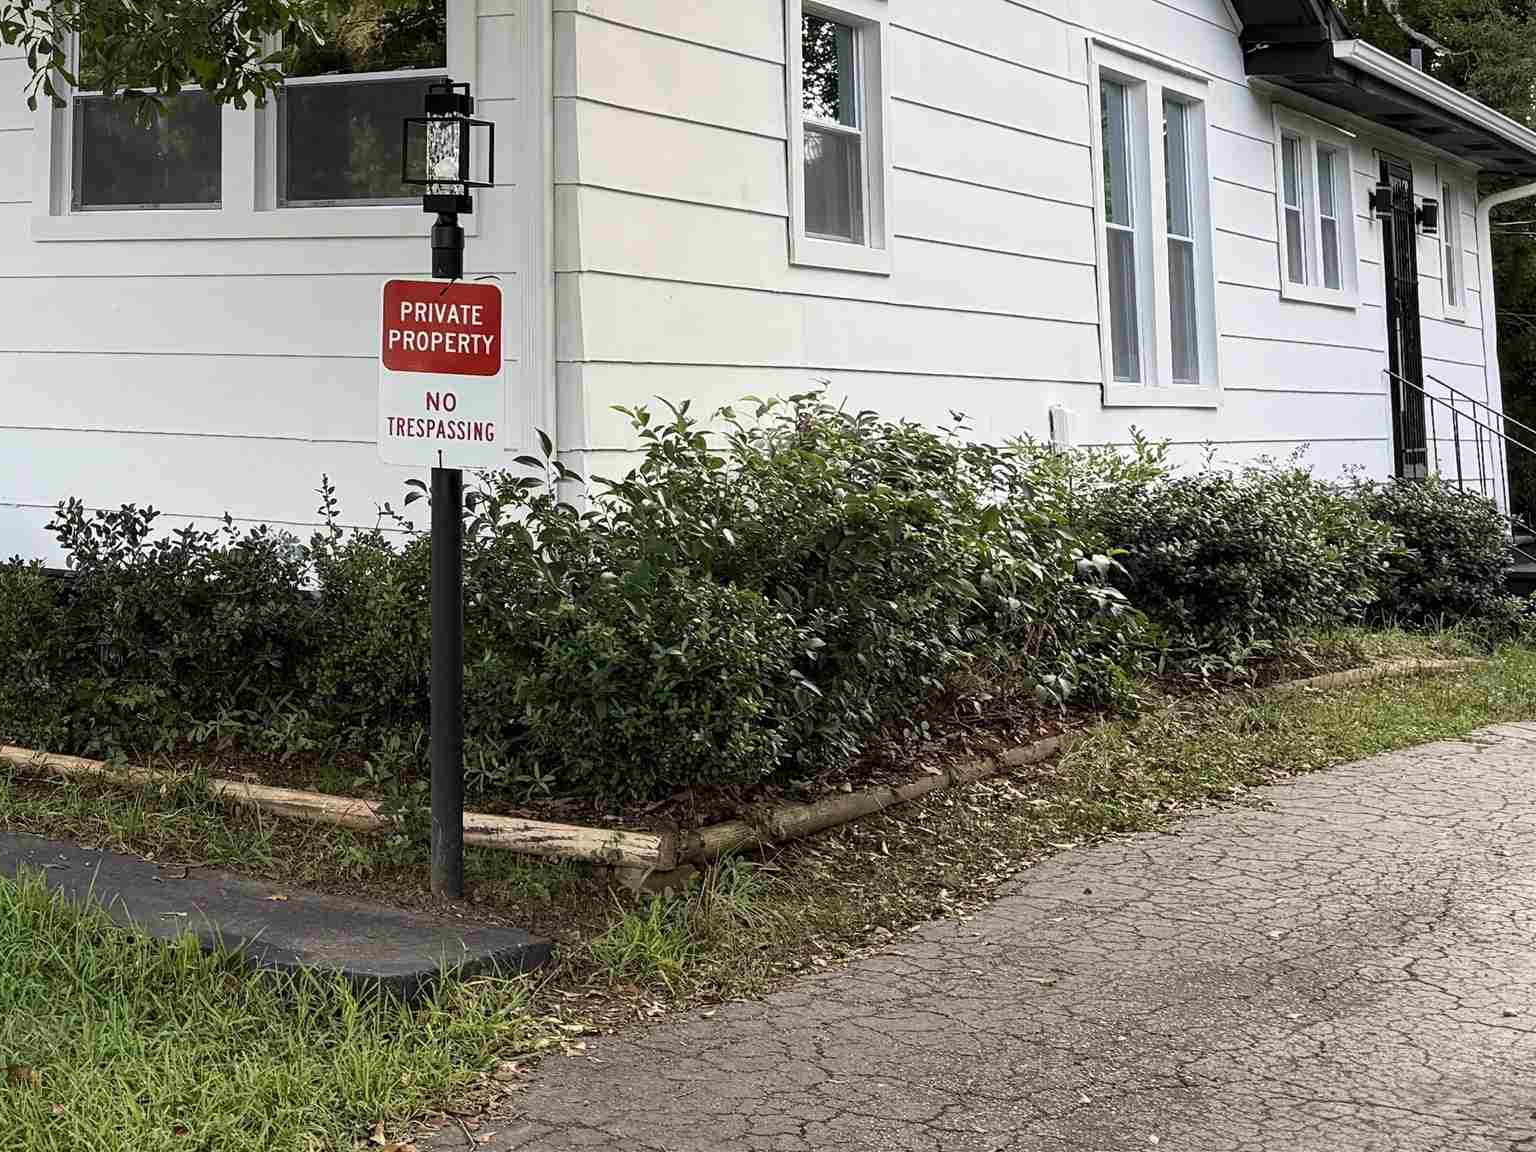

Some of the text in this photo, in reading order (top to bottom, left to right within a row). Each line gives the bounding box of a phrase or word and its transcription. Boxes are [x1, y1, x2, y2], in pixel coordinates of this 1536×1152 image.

[400, 301, 483, 326] PRIVATE
[389, 329, 494, 354] PROPERTY
[426, 391, 457, 412] NO
[387, 417, 495, 442] TRESPASSING
